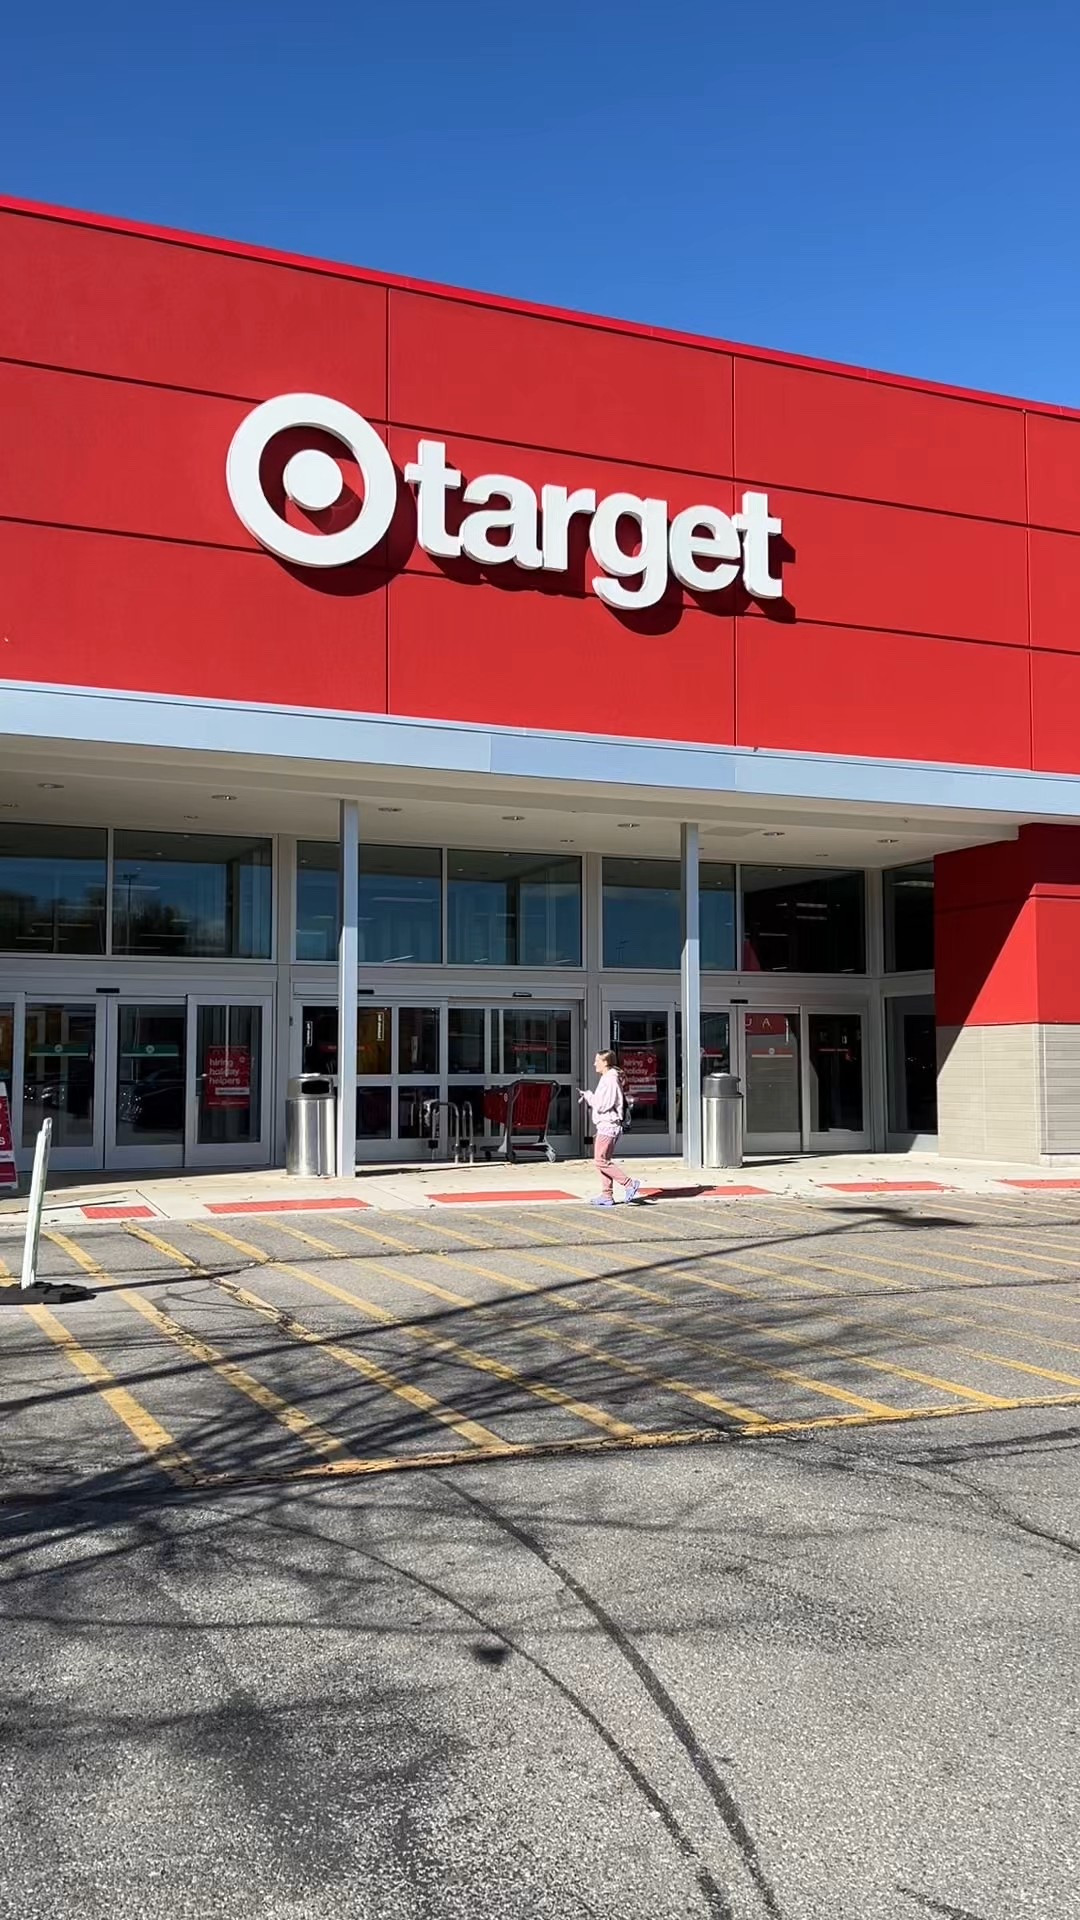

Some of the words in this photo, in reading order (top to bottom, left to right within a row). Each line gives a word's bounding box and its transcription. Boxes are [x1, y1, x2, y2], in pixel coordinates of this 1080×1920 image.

[404, 439, 782, 610] target
[209, 1057, 233, 1067] hiring
[623, 1058, 644, 1068] hiring
[209, 1076, 241, 1085] helpers
